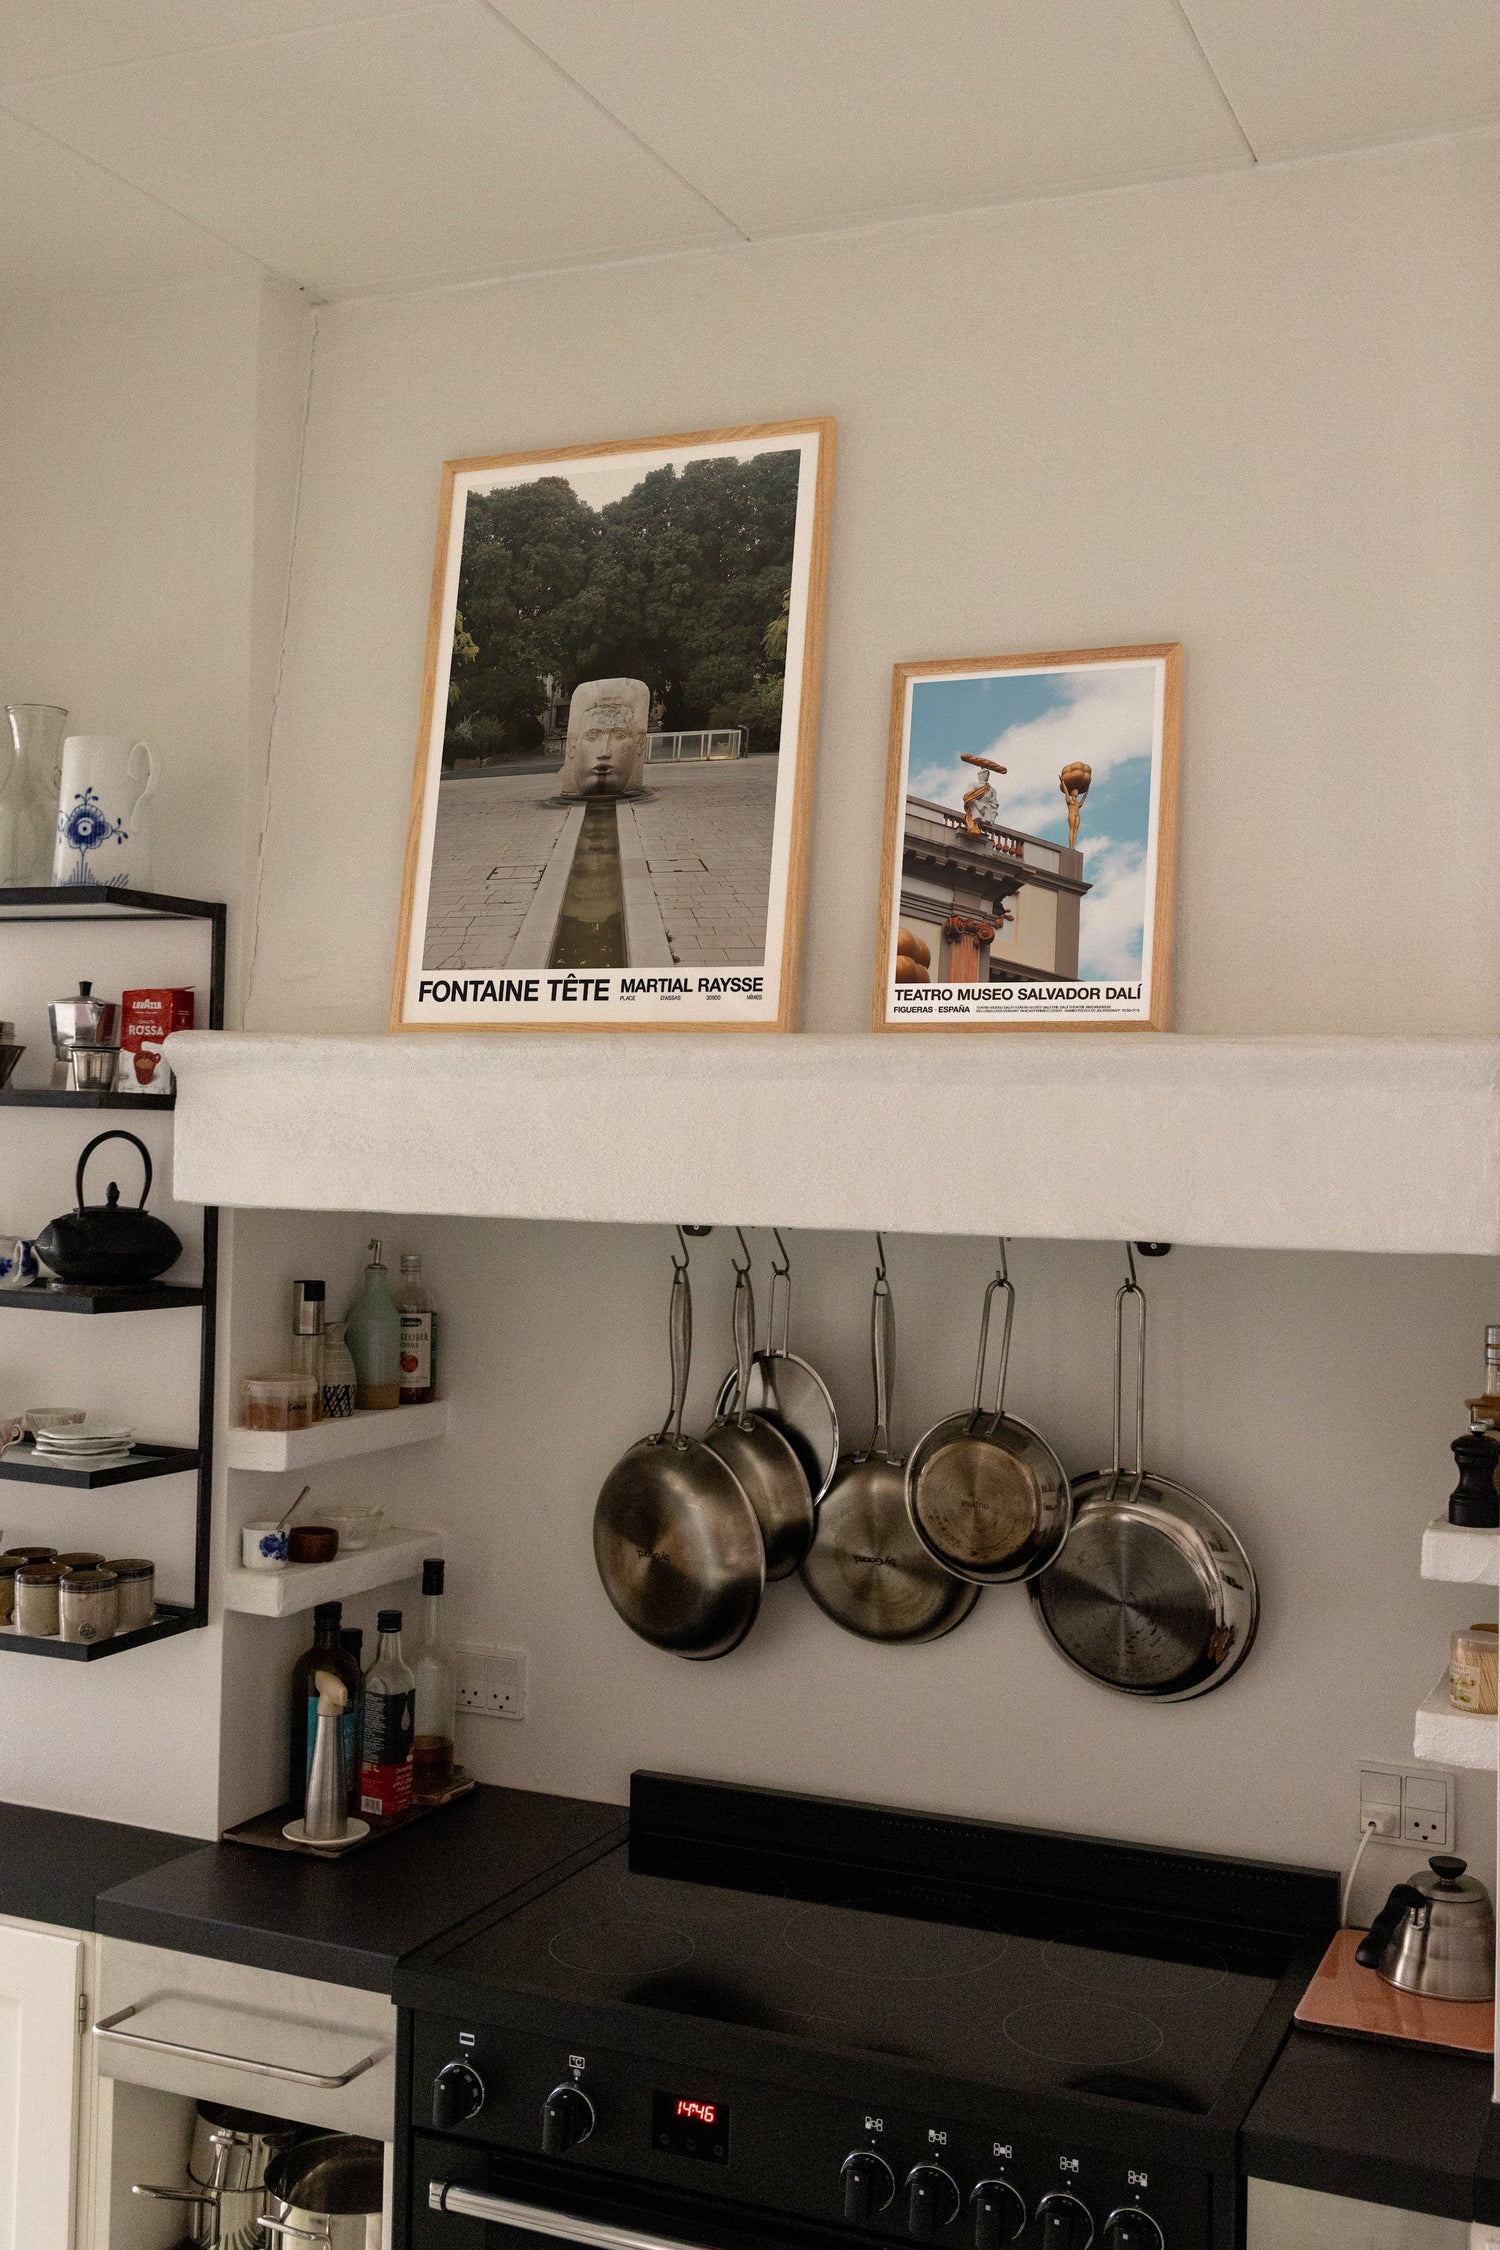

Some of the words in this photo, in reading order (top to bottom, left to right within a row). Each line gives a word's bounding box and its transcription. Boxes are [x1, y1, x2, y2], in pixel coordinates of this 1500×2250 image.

[418, 979, 540, 1002] FONTAINE
[547, 973, 611, 1001] TÊTE
[620, 978, 694, 993] MARTIAL
[697, 977, 764, 992] RAYSSE
[894, 988, 953, 1001] TEATRO
[957, 988, 1014, 1001] MUSEO
[1017, 987, 1101, 1000] SALVADOR
[1106, 984, 1143, 1000] DALÍ
[893, 1006, 934, 1014] FIGUERAS
[938, 1004, 971, 1014] ESPAÑA
[128, 1025, 164, 1035] ROSSA
[677, 2101, 714, 2122] 14:46
